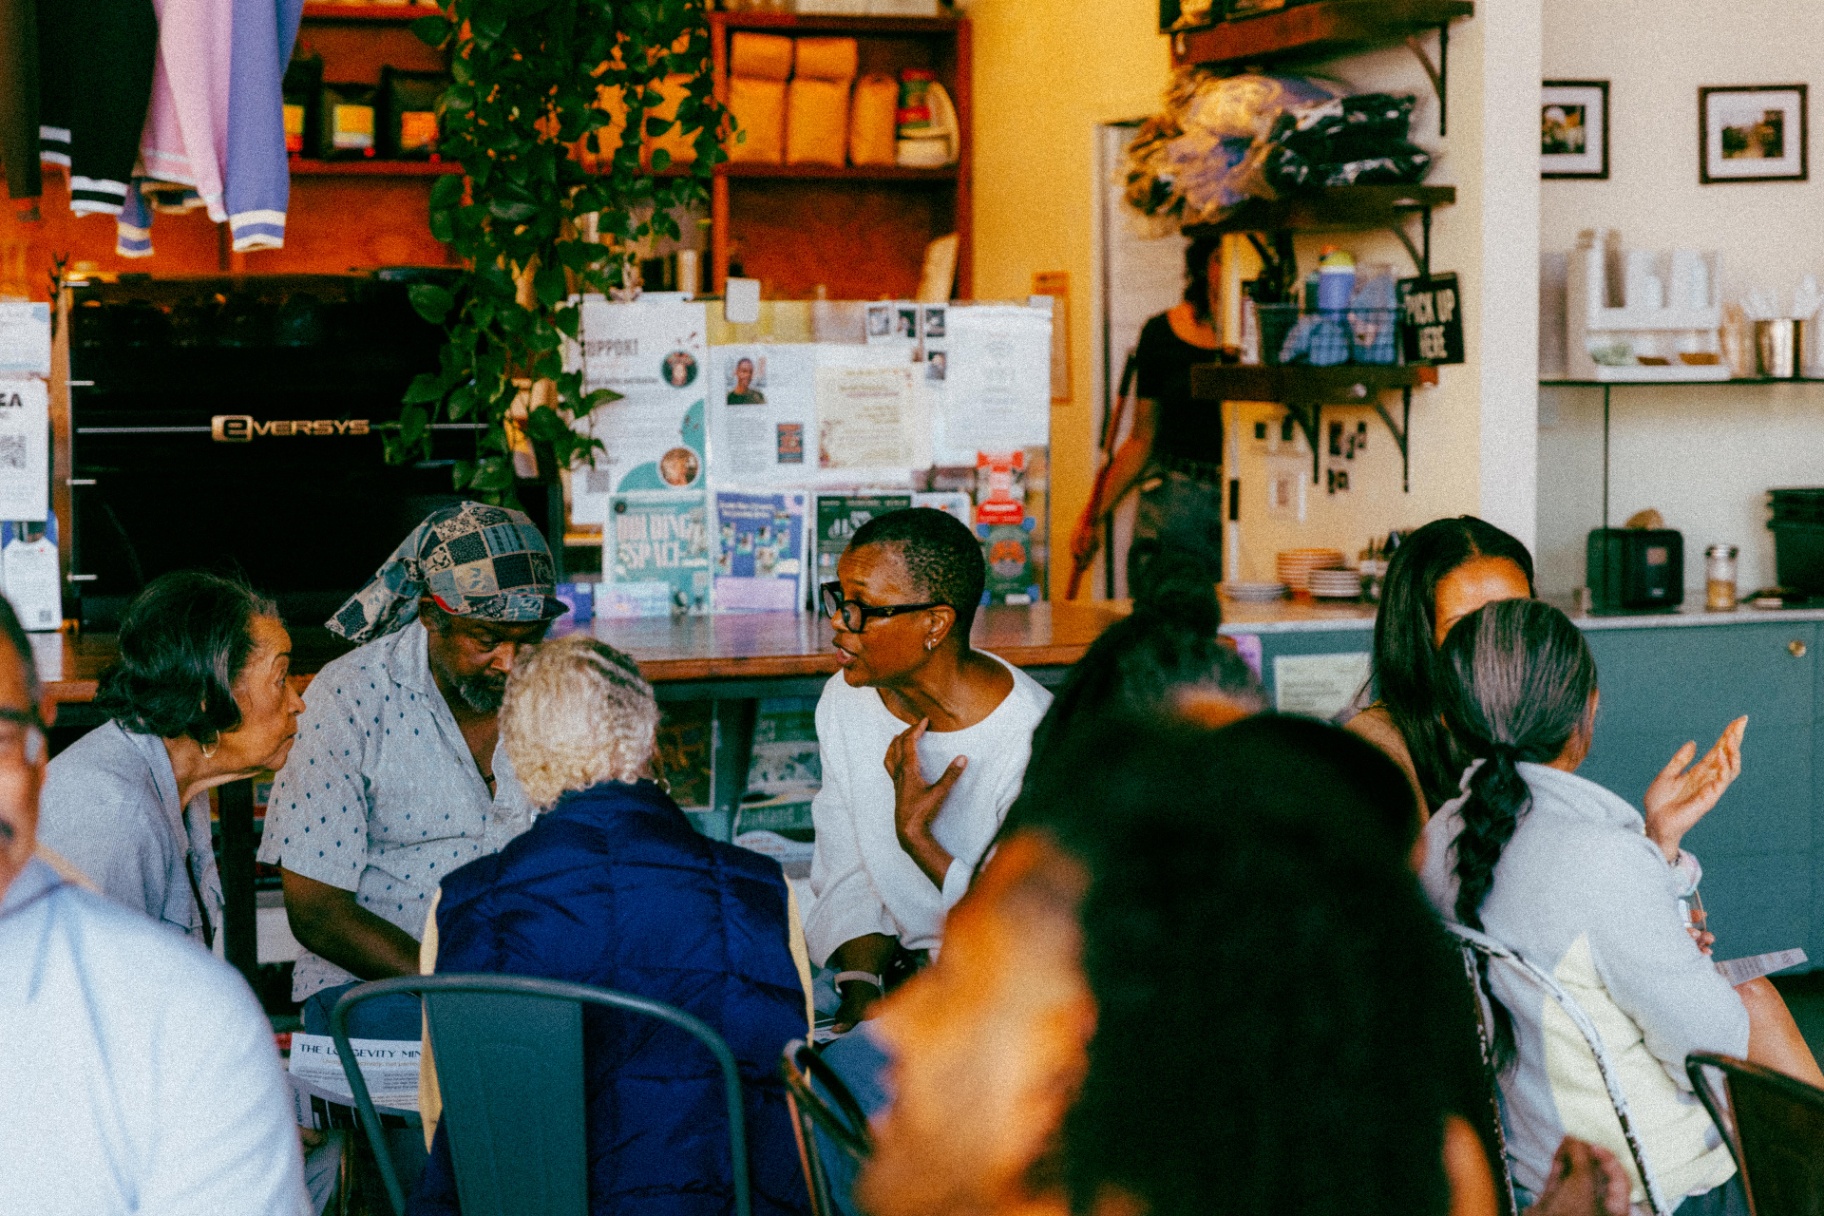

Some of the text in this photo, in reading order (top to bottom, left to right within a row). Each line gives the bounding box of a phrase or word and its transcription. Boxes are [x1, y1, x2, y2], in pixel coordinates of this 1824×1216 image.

[1405, 288, 1455, 325] PICK UP
[587, 338, 639, 357] UPPORT
[1418, 325, 1448, 359] HERE
[300, 1044, 322, 1055] THE
[327, 1048, 396, 1058] LOGEVITY
